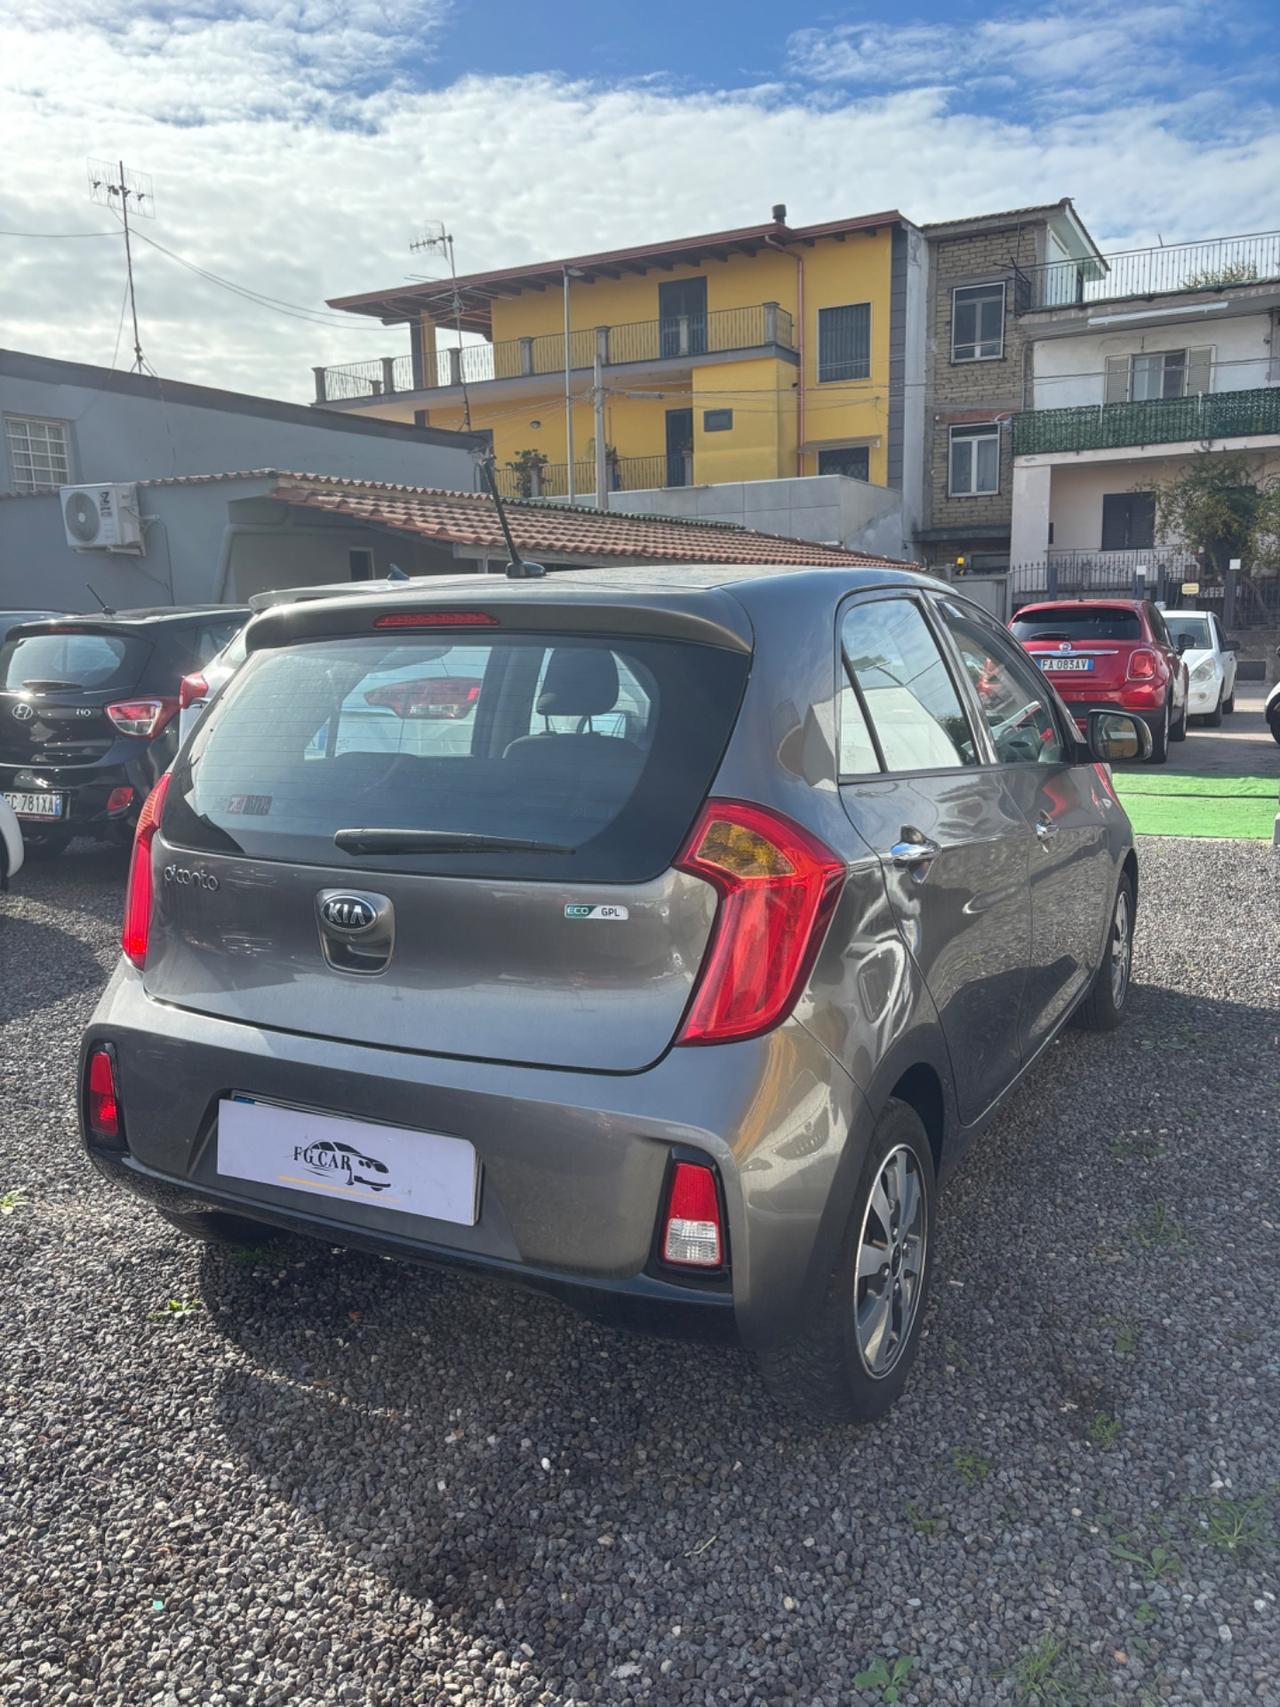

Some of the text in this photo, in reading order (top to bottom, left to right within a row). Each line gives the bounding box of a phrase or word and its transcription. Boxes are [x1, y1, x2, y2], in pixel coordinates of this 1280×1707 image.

[1056, 659, 1088, 669] 083AV
[21, 794, 54, 813] 781XA
[329, 902, 366, 925] KIA
[567, 907, 589, 915] ECO
[601, 908, 621, 917] GPL
[318, 1151, 352, 1171] CAR
